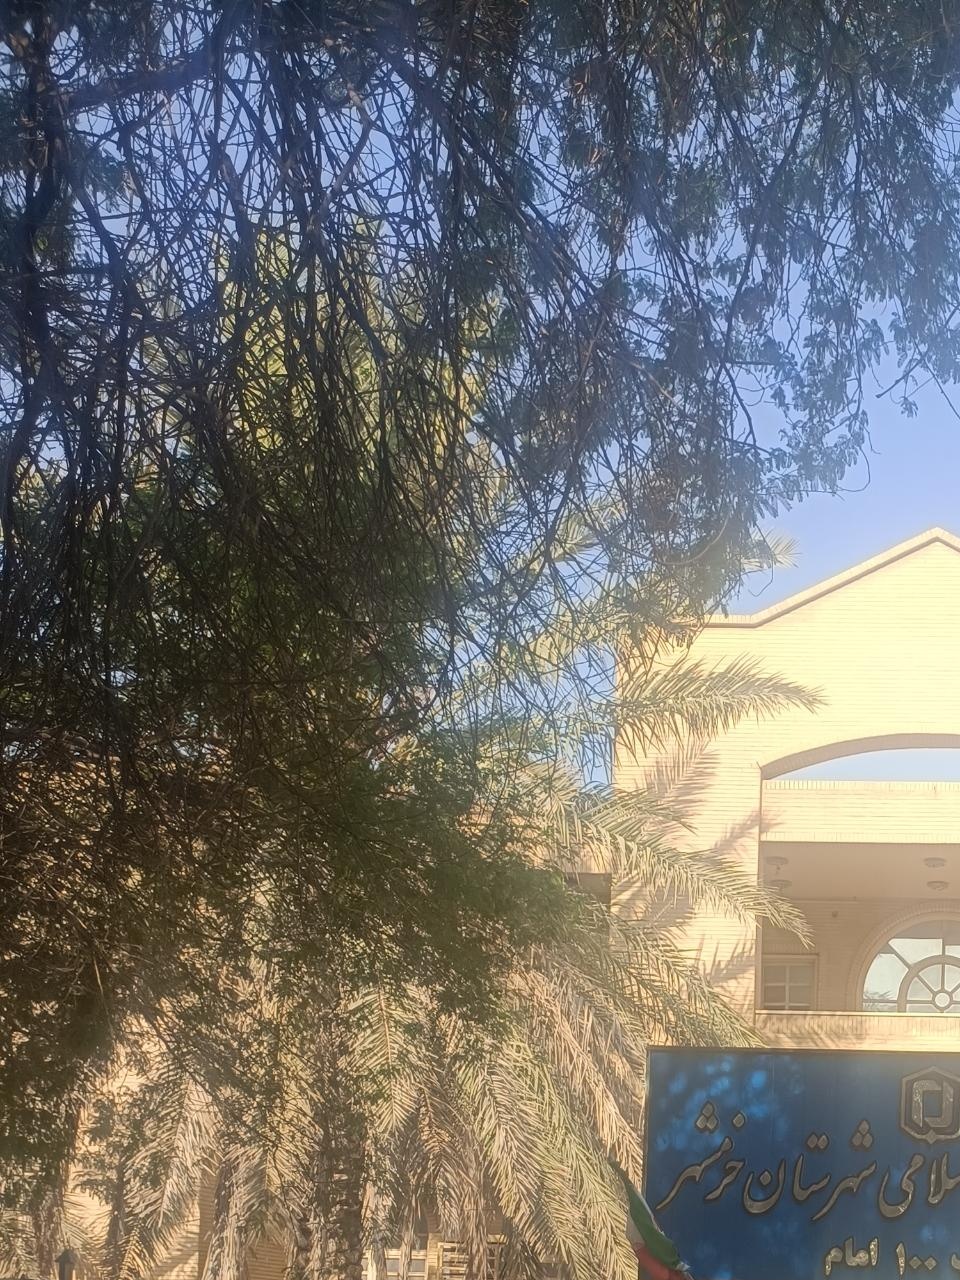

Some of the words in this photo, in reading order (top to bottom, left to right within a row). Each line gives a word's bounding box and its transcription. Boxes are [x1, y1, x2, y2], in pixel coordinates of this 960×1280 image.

[654, 1101, 747, 1212] خرمشهر
[742, 1118, 878, 1222] شهرستان
[824, 1236, 880, 1277] امام
[895, 1241, 938, 1277] ۱۰۰
